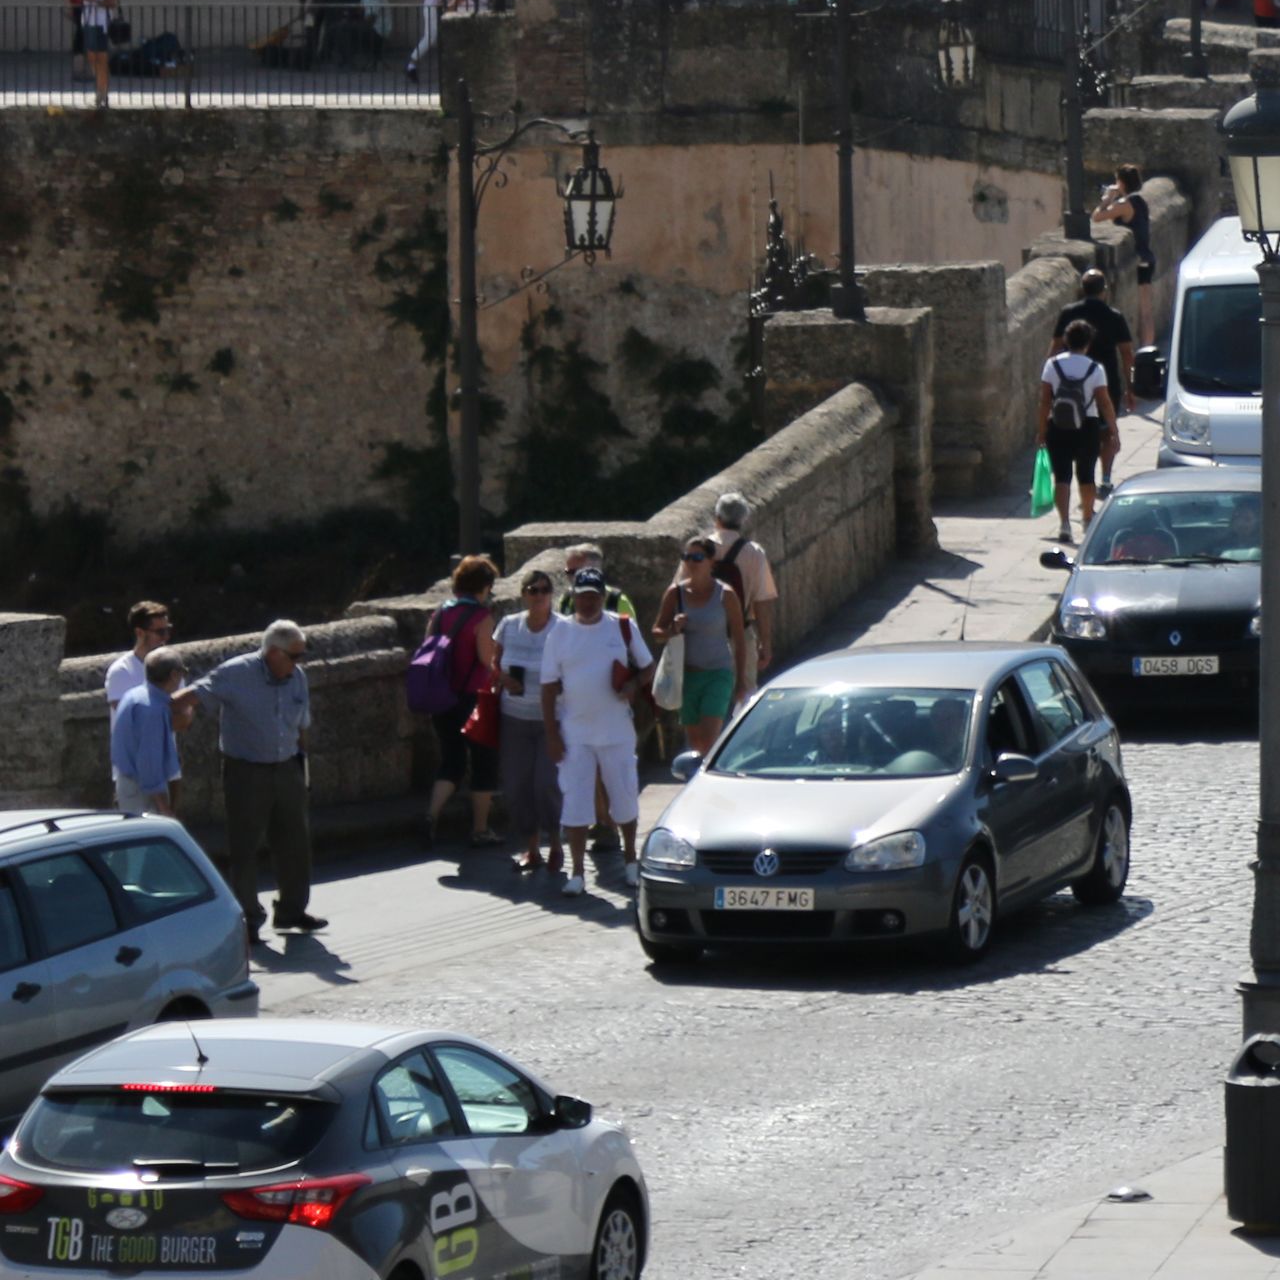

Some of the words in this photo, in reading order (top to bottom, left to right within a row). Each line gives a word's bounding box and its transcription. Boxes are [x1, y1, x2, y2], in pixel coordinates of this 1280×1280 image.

[1187, 658, 1213, 673] DGS
[727, 890, 769, 906] 3647
[775, 891, 809, 907] FMG
[47, 1216, 83, 1261] TGB
[430, 1181, 478, 1280] GB
[90, 1234, 113, 1262] THE
[118, 1235, 155, 1263] GOOD
[159, 1236, 215, 1264] BURGER
